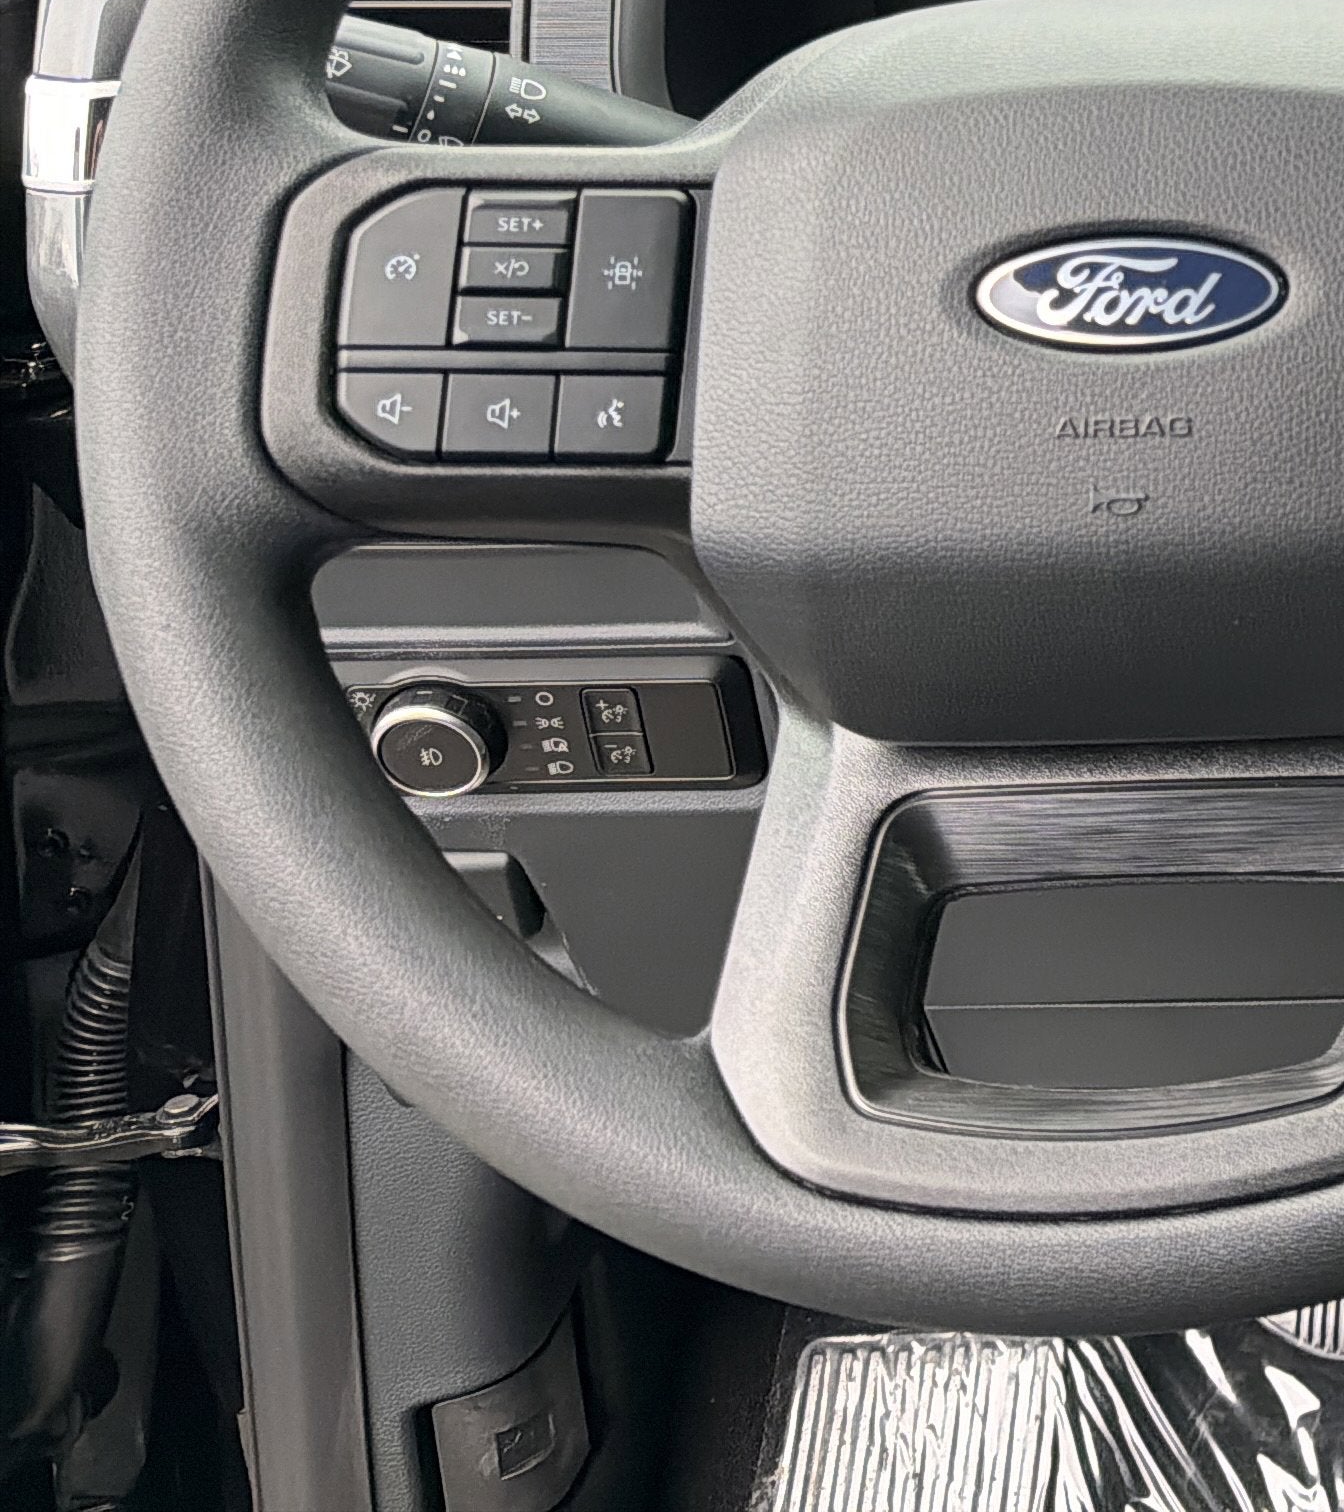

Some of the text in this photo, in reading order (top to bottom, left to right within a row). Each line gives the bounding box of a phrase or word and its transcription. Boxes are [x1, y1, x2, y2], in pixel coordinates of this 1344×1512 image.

[497, 217, 545, 233] SET+
[1036, 254, 1223, 326] Ford
[1055, 416, 1194, 439] AIRBAG
